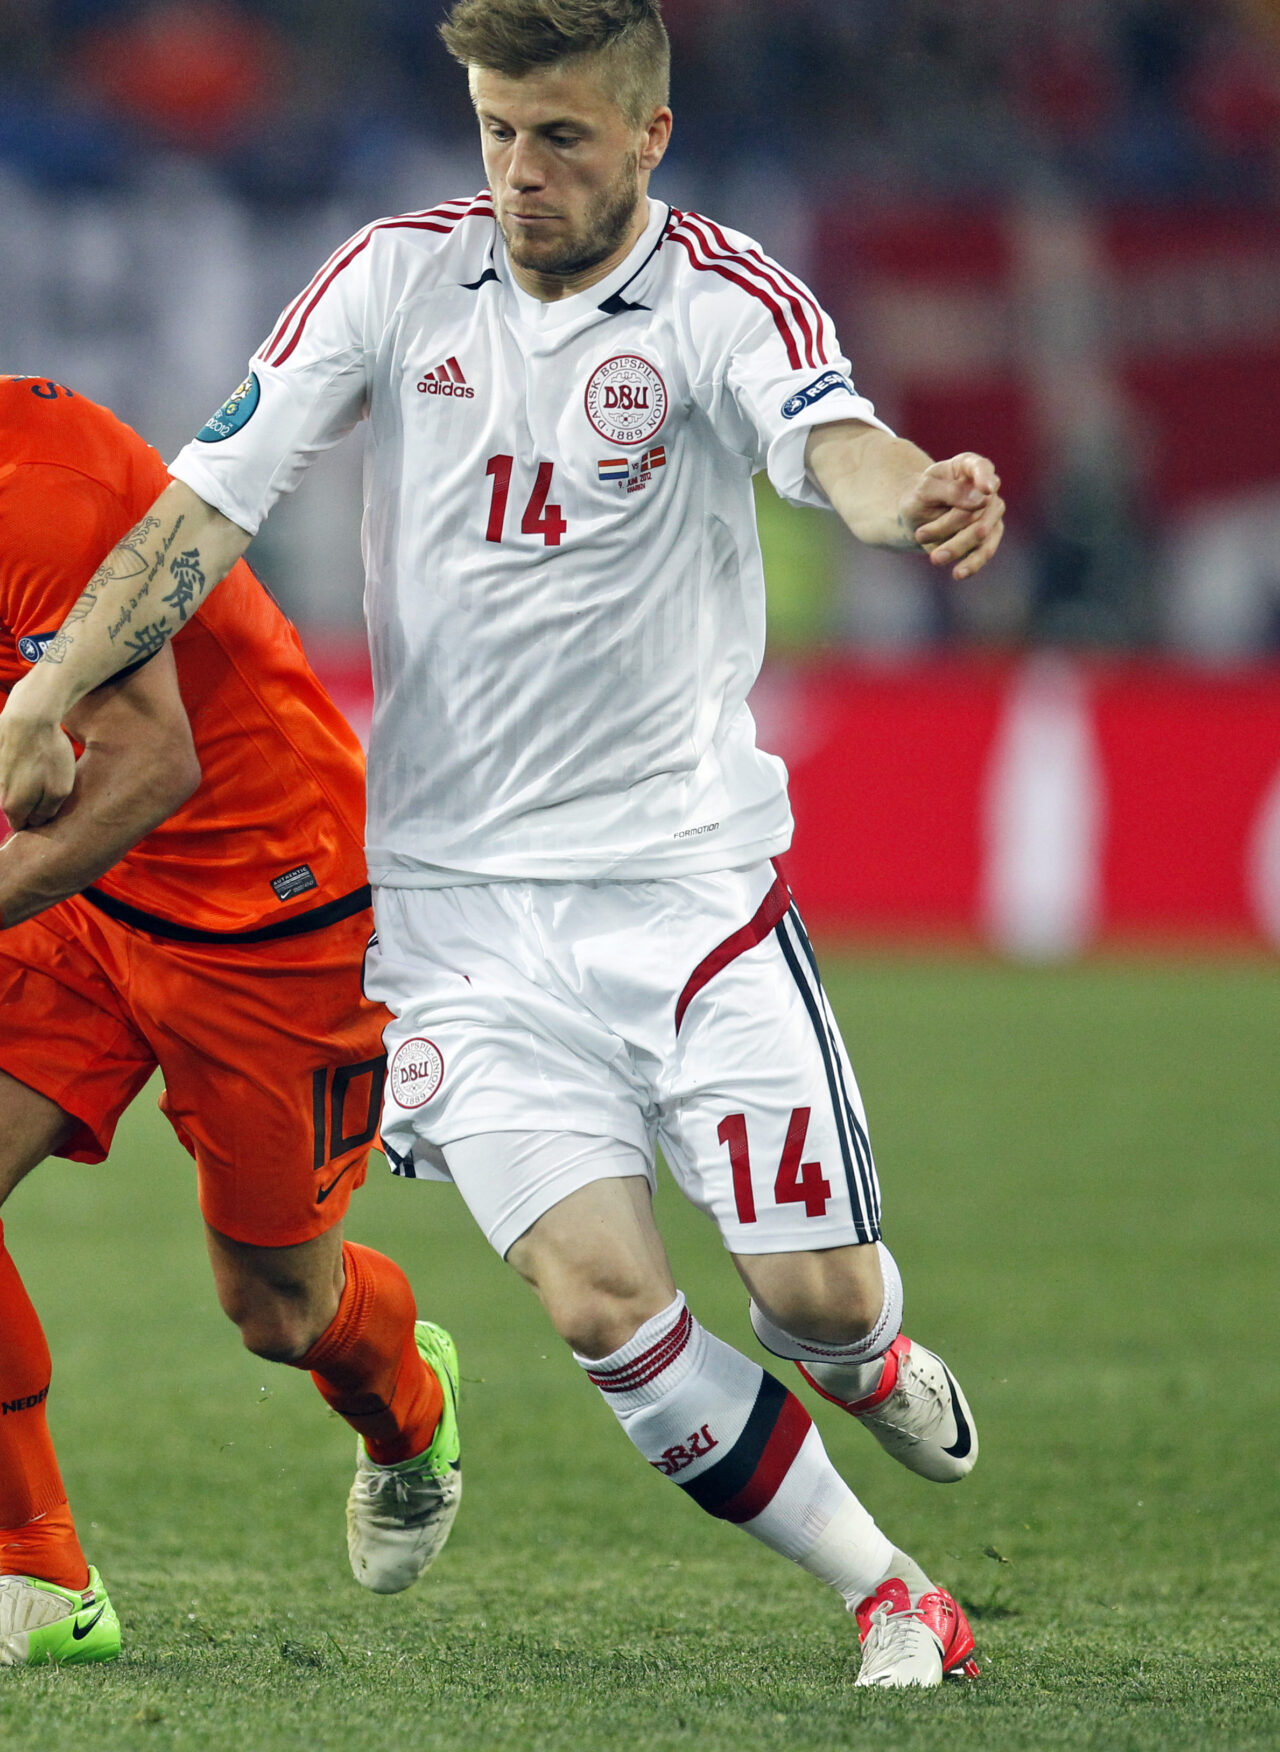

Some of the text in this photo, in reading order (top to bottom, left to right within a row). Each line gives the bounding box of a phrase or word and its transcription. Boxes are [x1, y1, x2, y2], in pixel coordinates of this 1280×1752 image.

[417, 380, 475, 399] adidas
[603, 384, 650, 410] DBU
[610, 429, 643, 441] 1889
[485, 454, 567, 546] 14
[400, 1061, 430, 1084] DBU
[313, 1053, 388, 1171] 10
[717, 1107, 832, 1224] 14
